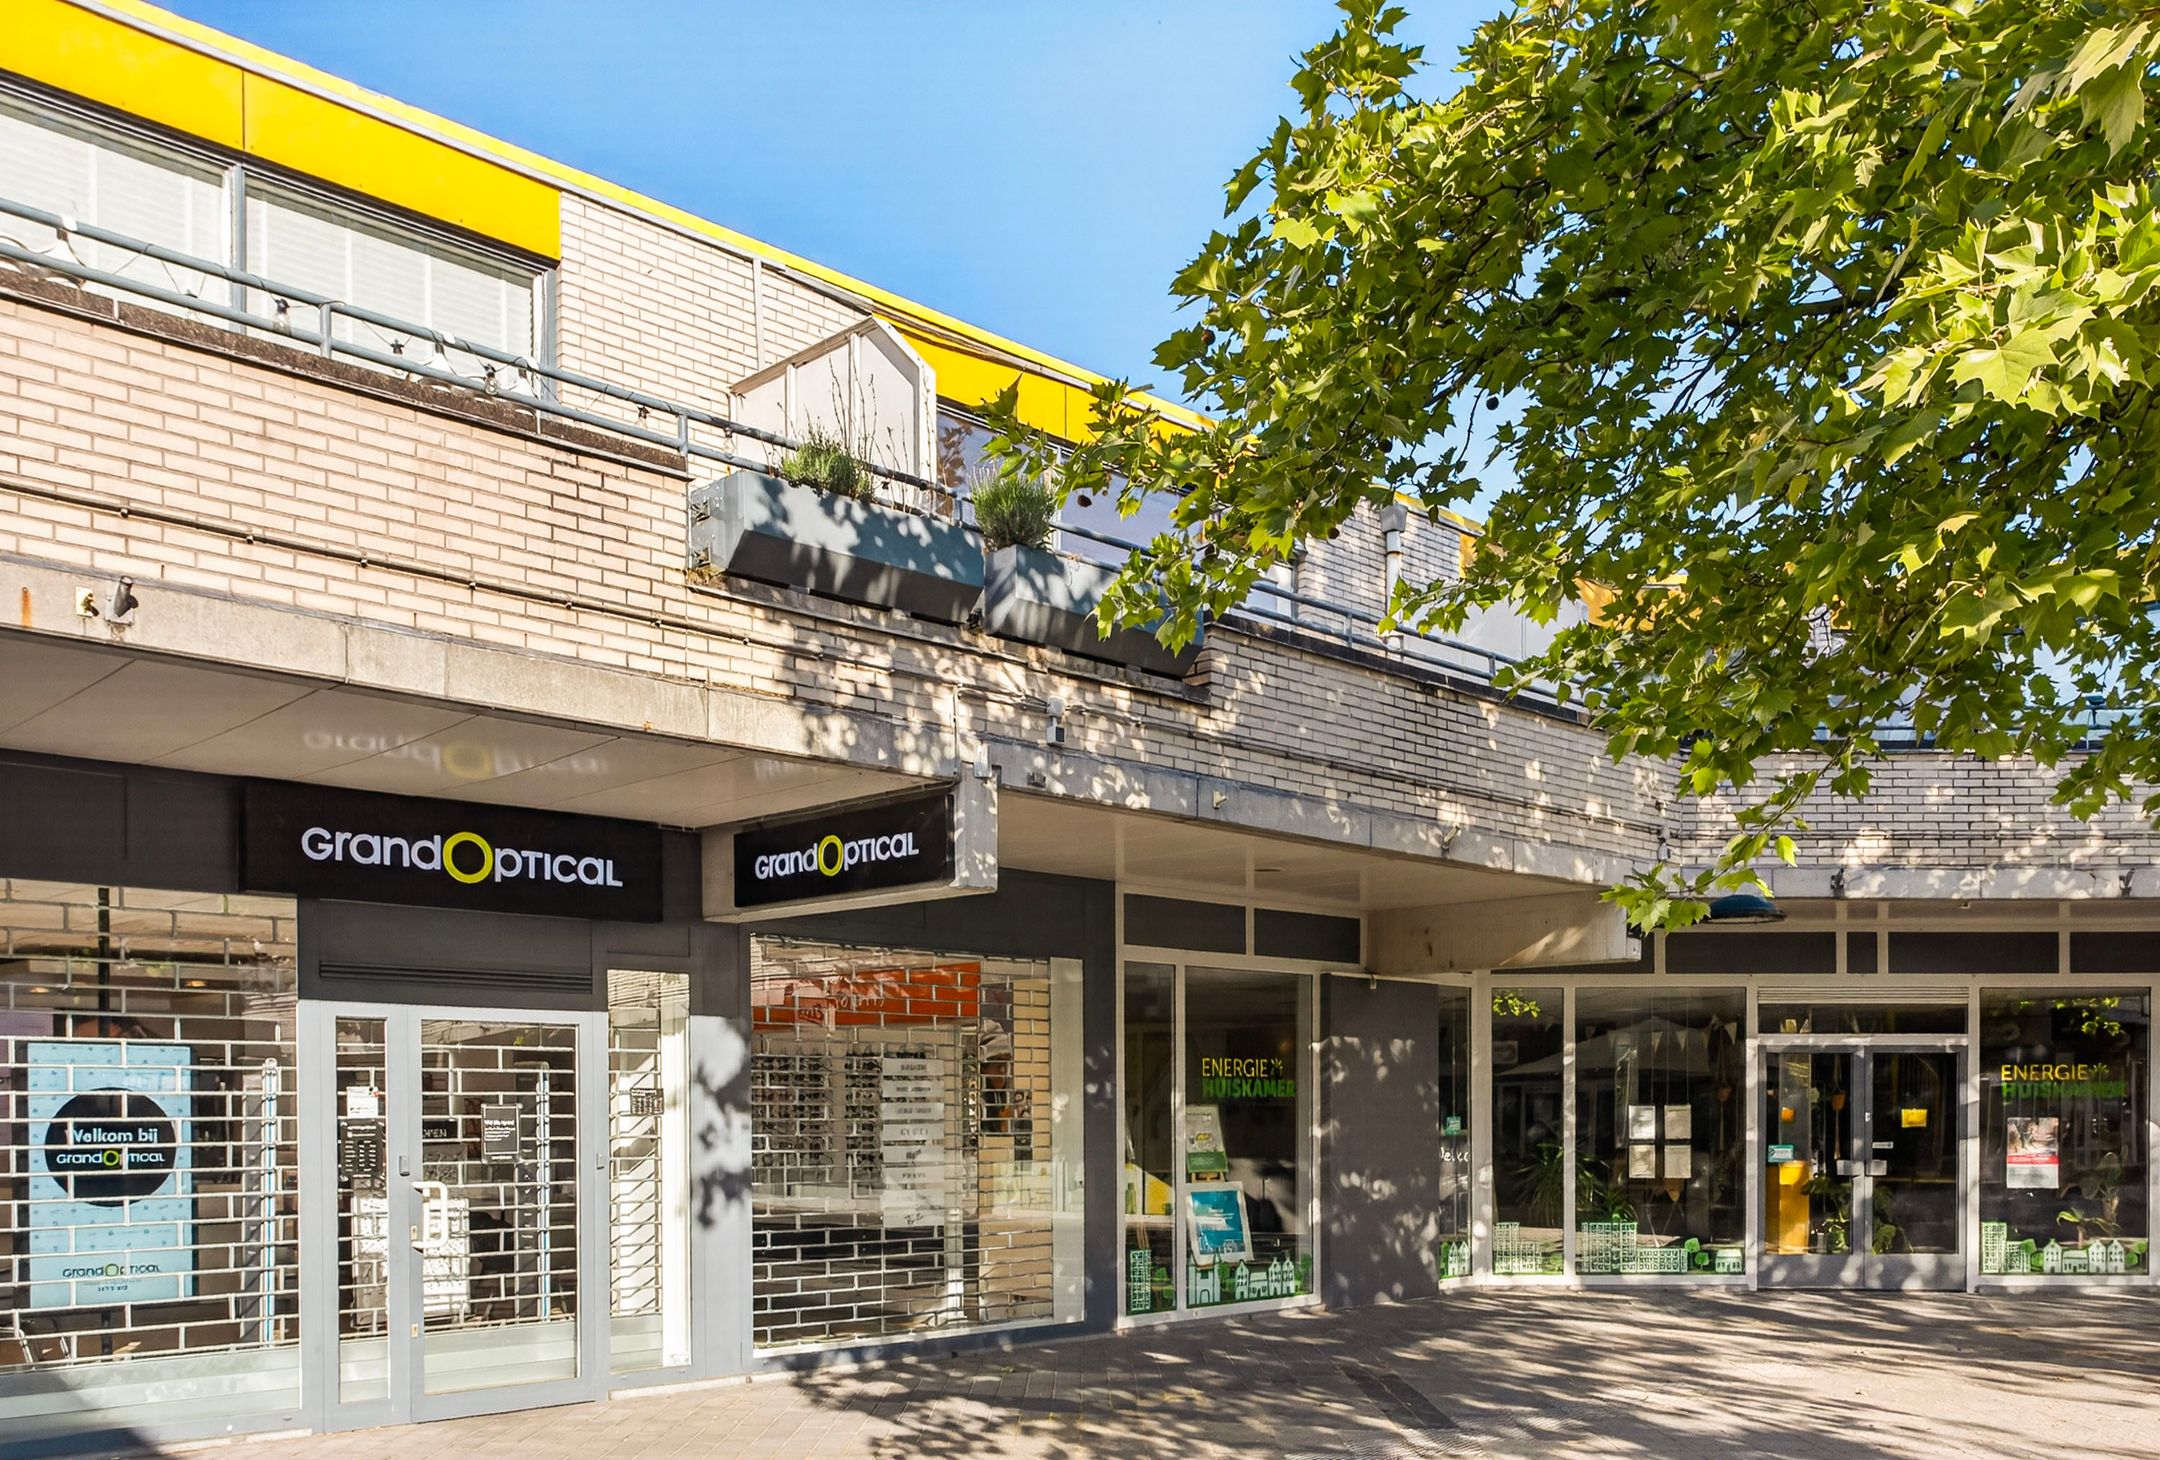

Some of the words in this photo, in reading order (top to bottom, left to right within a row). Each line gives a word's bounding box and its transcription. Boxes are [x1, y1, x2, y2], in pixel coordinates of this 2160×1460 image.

[1201, 1057, 1269, 1078] ENERGIE
[2001, 1063, 2090, 1081] ENERGIE
[138, 1128, 158, 1145] bij
